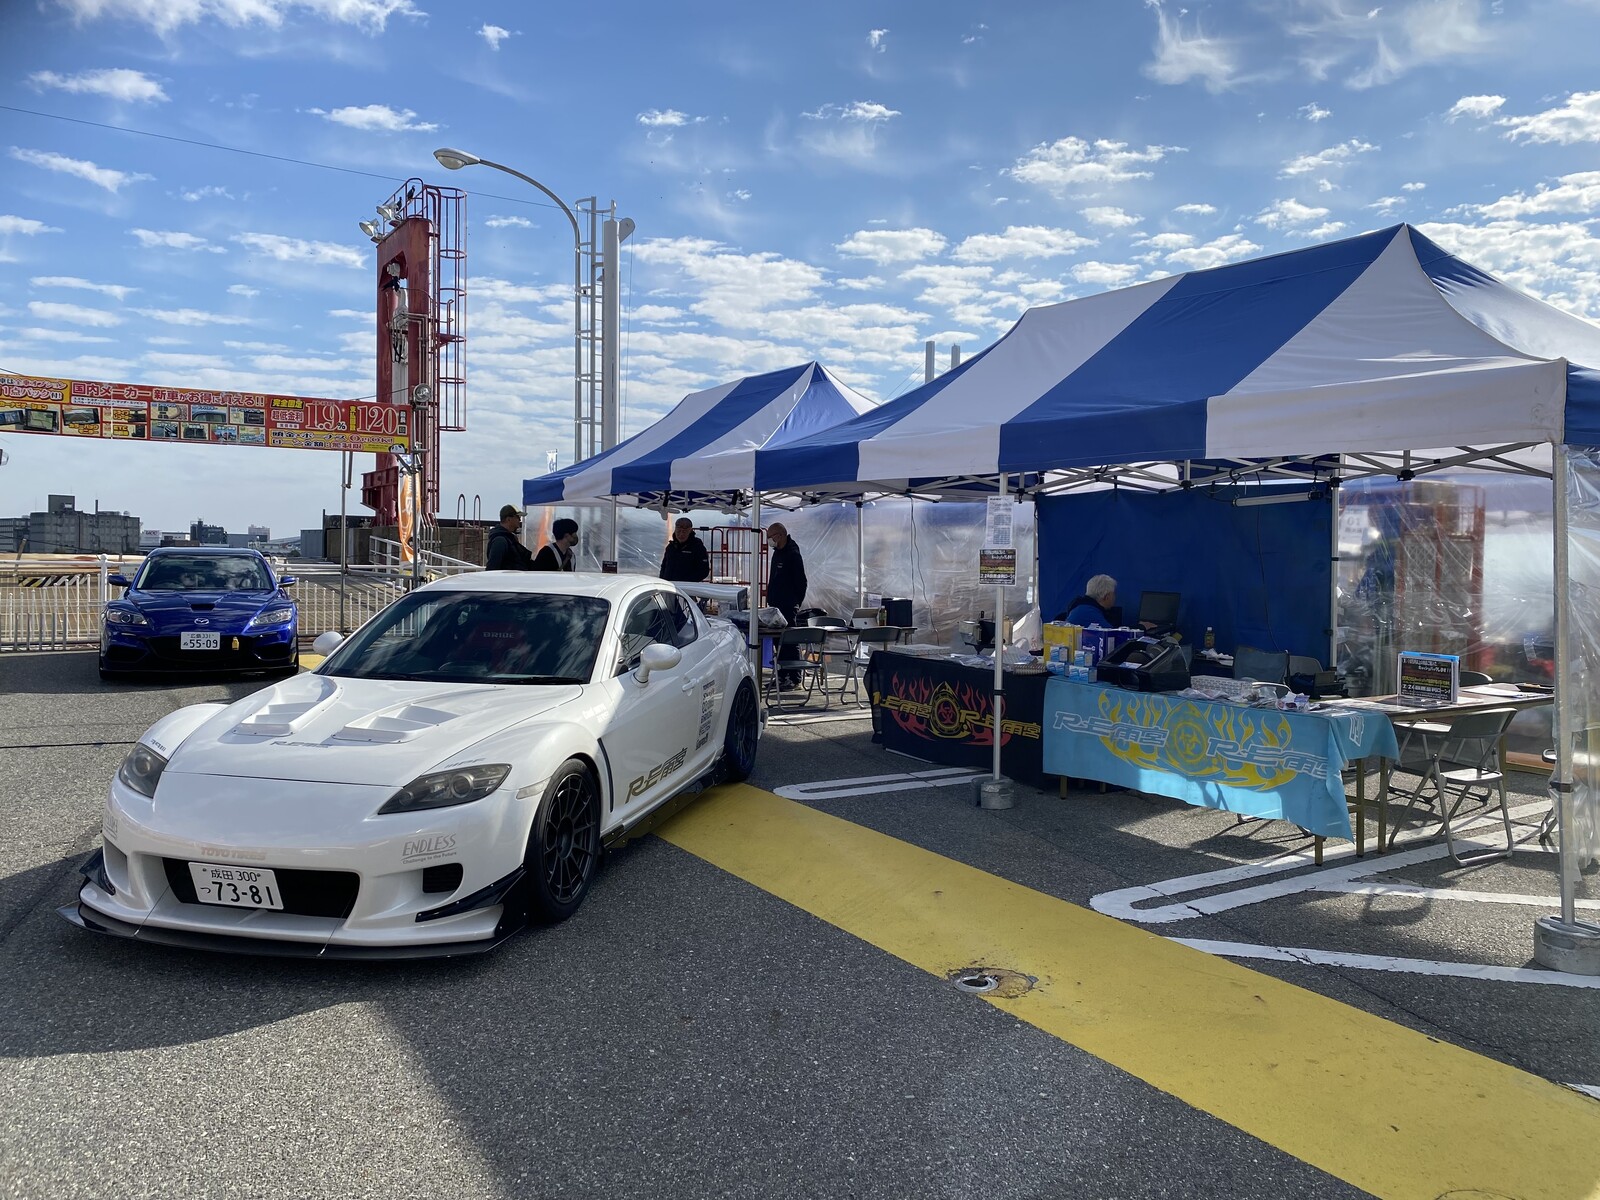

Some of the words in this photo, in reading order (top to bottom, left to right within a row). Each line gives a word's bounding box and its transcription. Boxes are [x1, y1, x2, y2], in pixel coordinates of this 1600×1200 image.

[357, 405, 398, 435] 120
[190, 639, 218, 648] 55-09
[402, 833, 456, 856] ENDLESS
[211, 869, 233, 880] 成田
[235, 870, 257, 882] 300
[212, 881, 274, 905] 73-81
